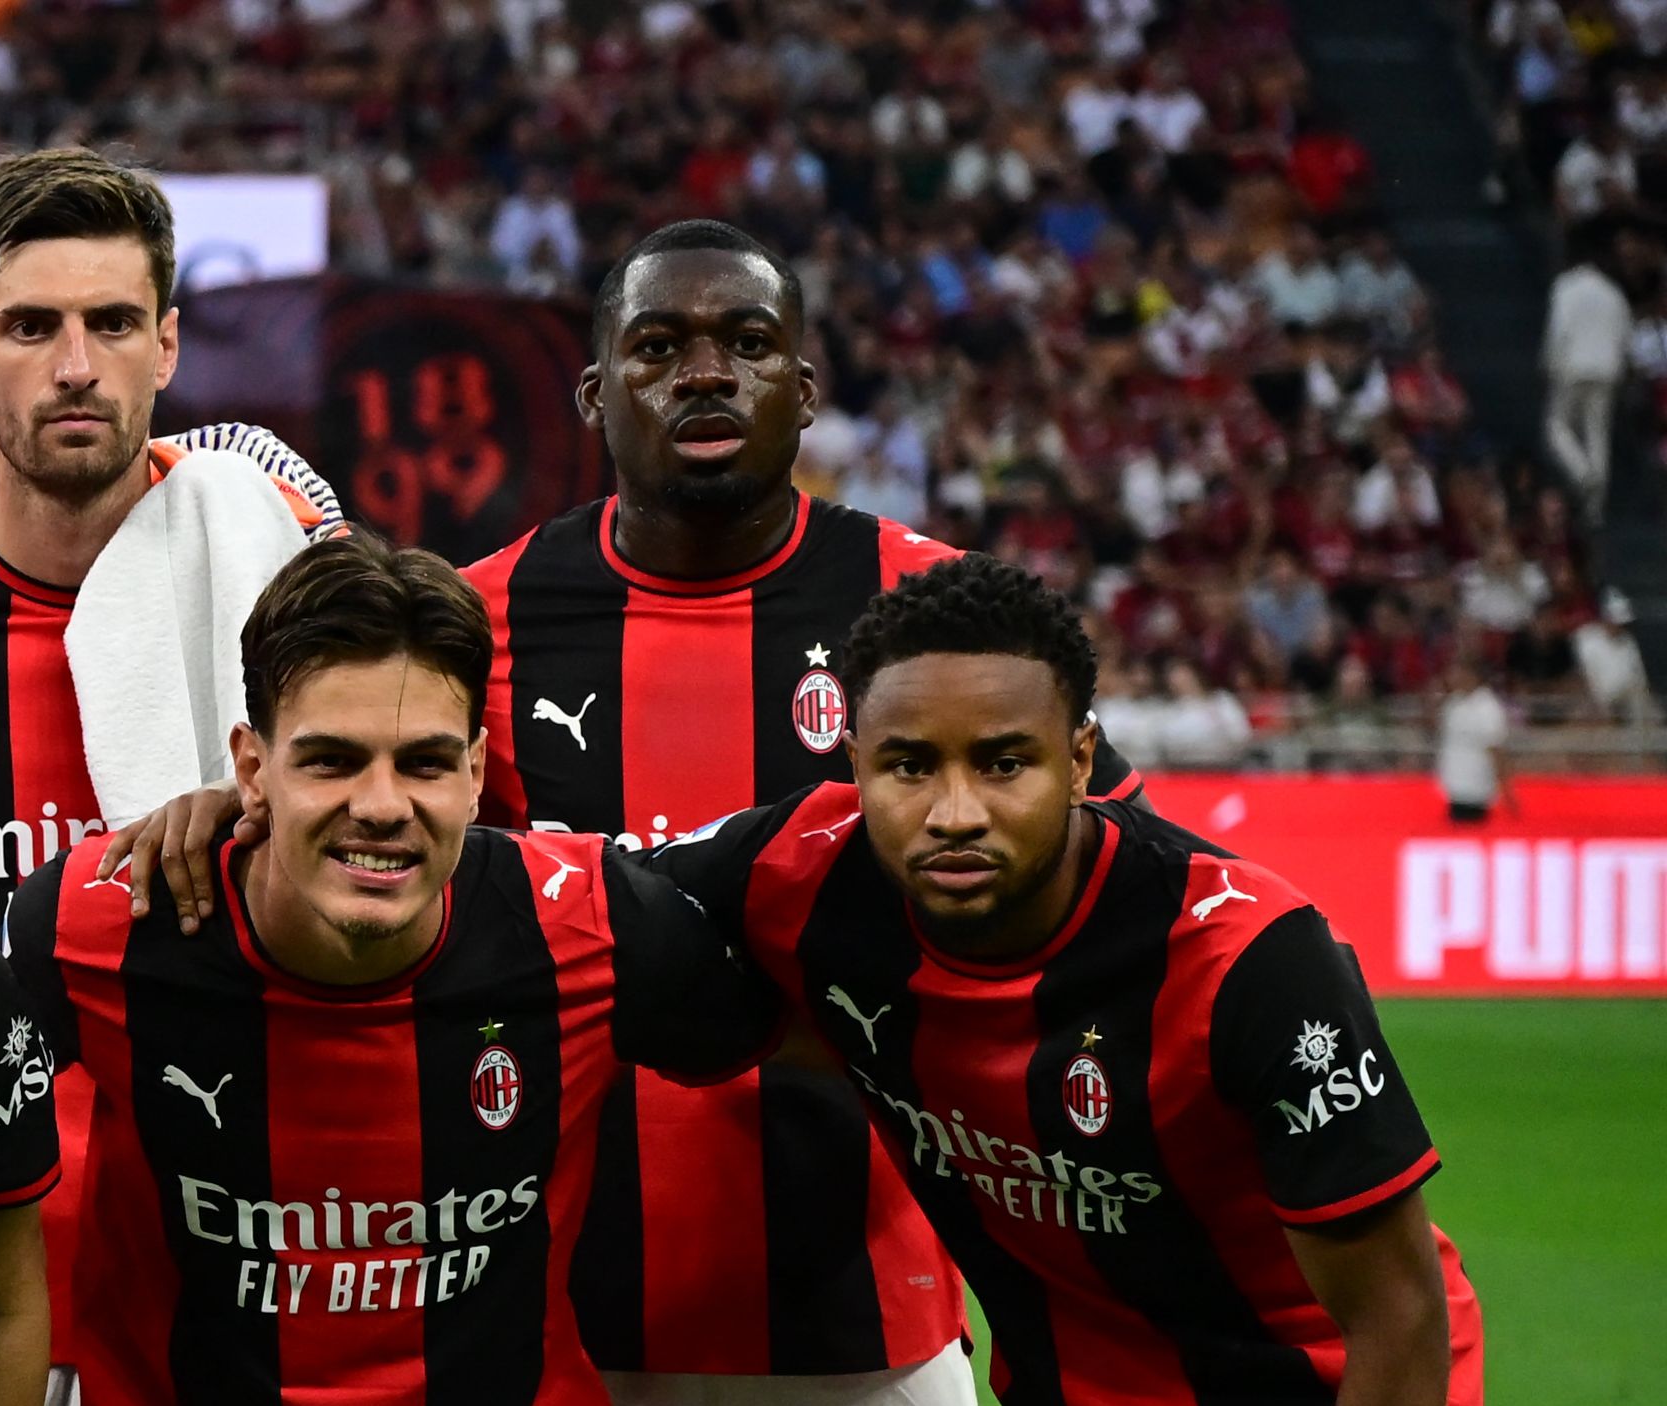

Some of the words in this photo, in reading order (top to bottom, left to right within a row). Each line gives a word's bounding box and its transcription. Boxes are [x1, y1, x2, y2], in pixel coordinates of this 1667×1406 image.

[804, 675, 835, 690] ACM
[808, 732, 834, 745] 1899
[480, 1053, 510, 1068] ACM
[1271, 1048, 1385, 1135] MSC
[486, 1108, 511, 1122] 1899
[178, 1174, 539, 1251] Emirates
[236, 1259, 312, 1315] FLY
[327, 1244, 490, 1314] BETTER
